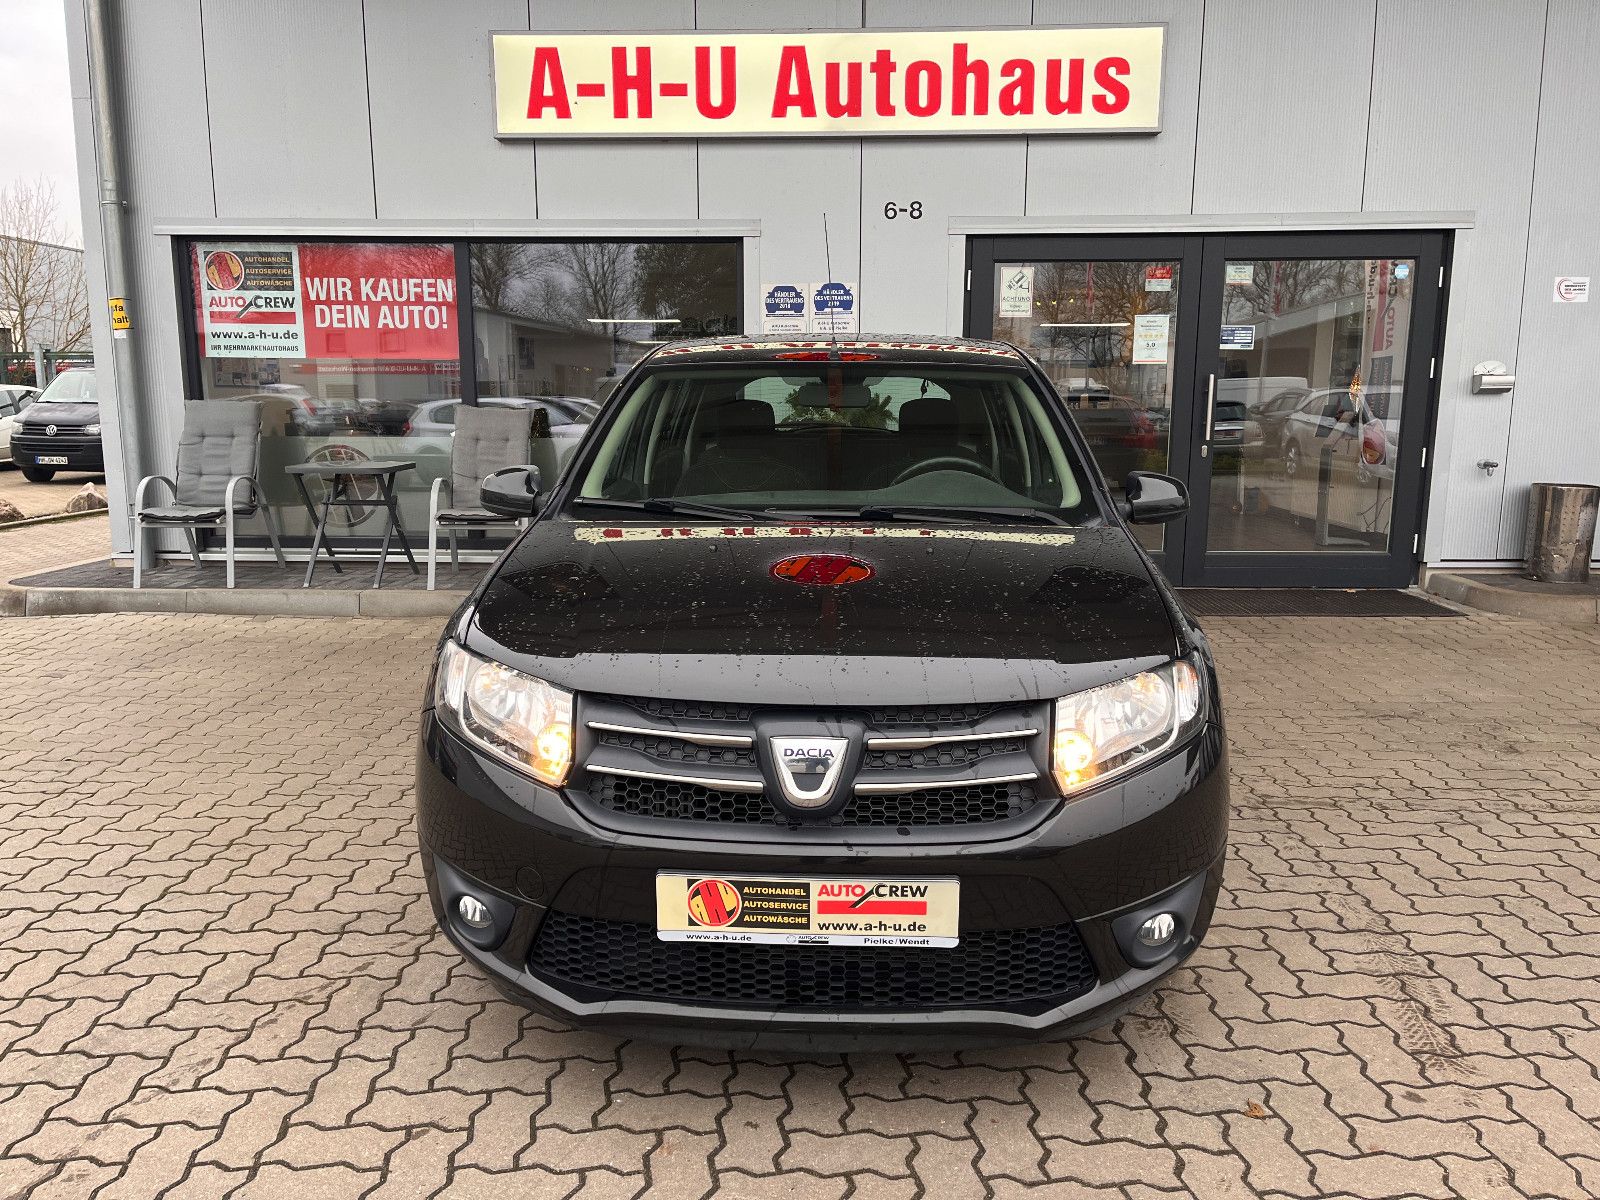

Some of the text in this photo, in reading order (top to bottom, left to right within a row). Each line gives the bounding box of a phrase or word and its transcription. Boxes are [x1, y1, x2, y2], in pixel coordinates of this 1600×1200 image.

[527, 43, 1130, 119] A-H-U Autohaus
[883, 202, 922, 220] 6-8
[245, 267, 293, 275] AUTOSERVICE
[246, 279, 293, 287] AUTOWÄSCHE
[305, 277, 453, 302] WIR KAUFEN
[208, 295, 296, 309] AUTO CREW
[315, 306, 448, 330] DEIN AUTO!
[211, 330, 299, 340] www.a-h-u.de
[783, 747, 835, 758] DACIA
[743, 884, 929, 898] AUTOHANDEL AUTO CREW
[743, 900, 809, 910] AUTOSERVICE
[743, 914, 927, 932] AUTOWÄSCHE www.a-h-u.de
[686, 934, 752, 942] www.a-h-u.de
[863, 937, 930, 946] Pielke/Wendt
